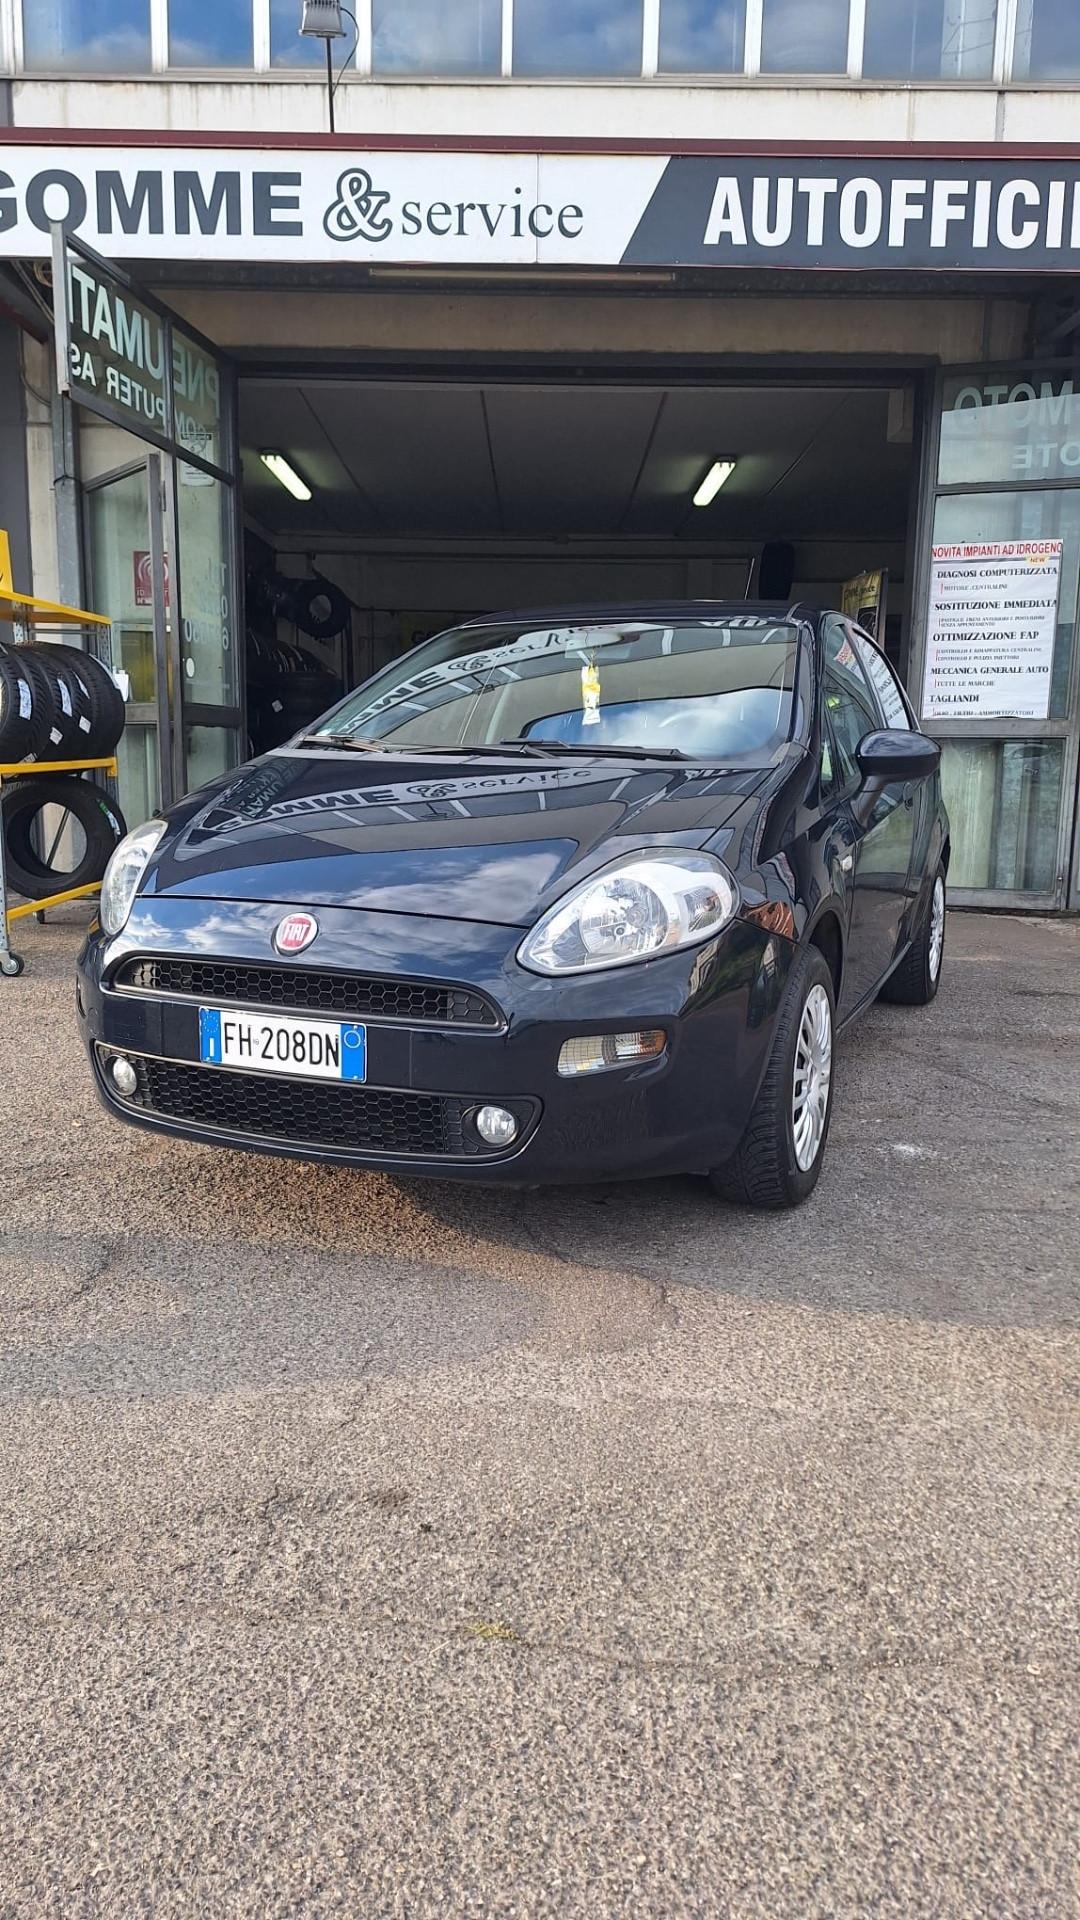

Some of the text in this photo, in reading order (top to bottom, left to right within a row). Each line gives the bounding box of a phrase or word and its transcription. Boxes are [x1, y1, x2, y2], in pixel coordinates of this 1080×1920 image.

[0, 169, 303, 237] OMME
[401, 186, 584, 239] service
[703, 176, 1080, 250] AUTOFFICI
[963, 545, 1000, 556] IMPIANTI
[1003, 544, 1015, 555] AD
[937, 567, 1058, 579] DIAGNOSI COMPUTERIZZATA
[934, 601, 1001, 611] SOSTITUZIONE
[933, 632, 1017, 642] OTTIMIZZAZIONE
[930, 667, 977, 675] MECCANICA
[980, 666, 1024, 674] GENERALE
[929, 694, 980, 703] TAGLIANDI
[283, 923, 309, 942] FIAT
